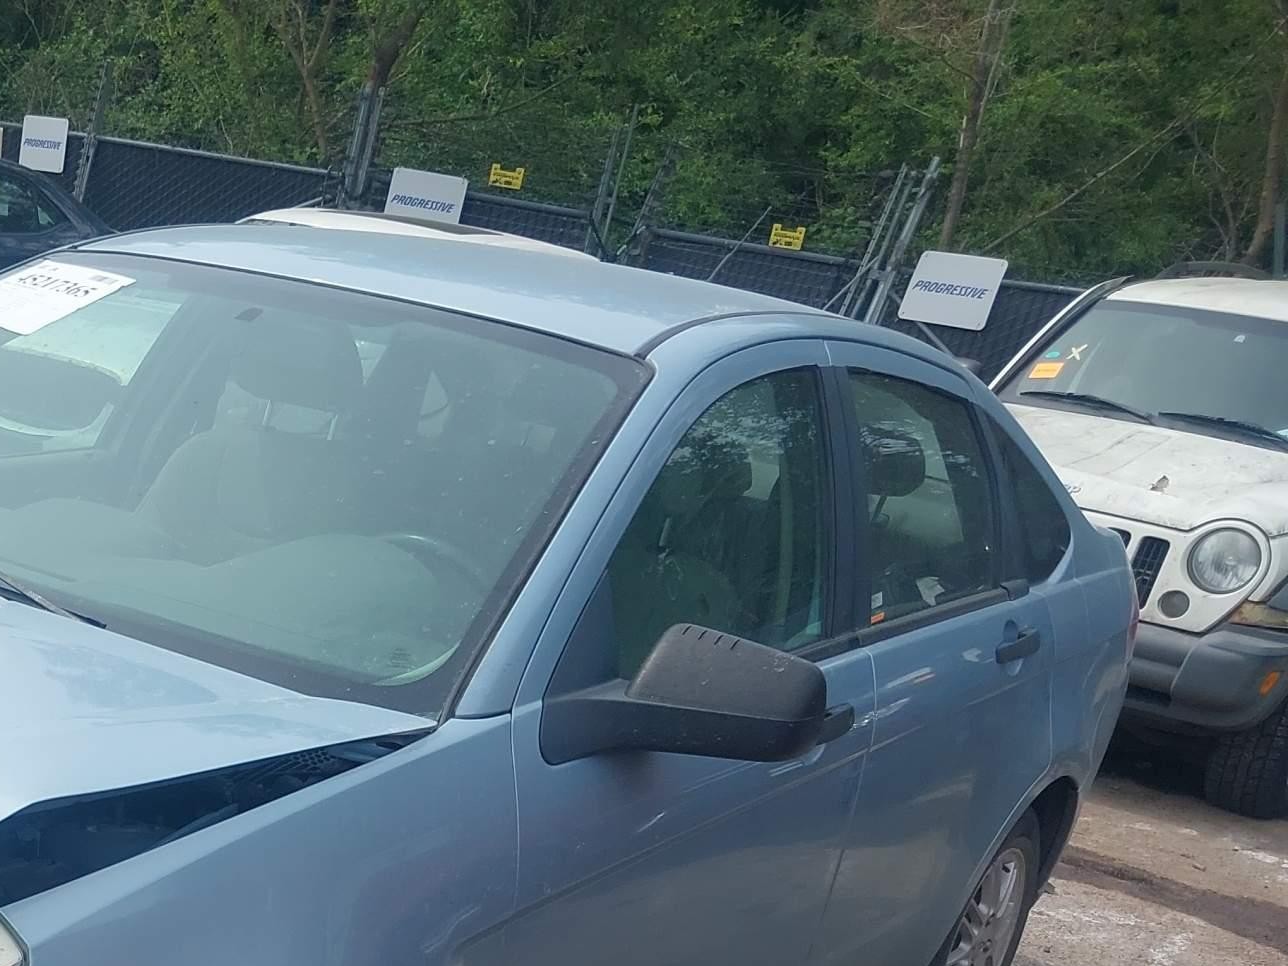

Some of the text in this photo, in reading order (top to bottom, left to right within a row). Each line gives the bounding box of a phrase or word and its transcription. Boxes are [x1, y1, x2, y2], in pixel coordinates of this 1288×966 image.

[23, 137, 64, 151] PROGRESSIVE
[391, 193, 457, 214] PROGRESSIVE
[912, 279, 990, 300] PROGRESSIVE
